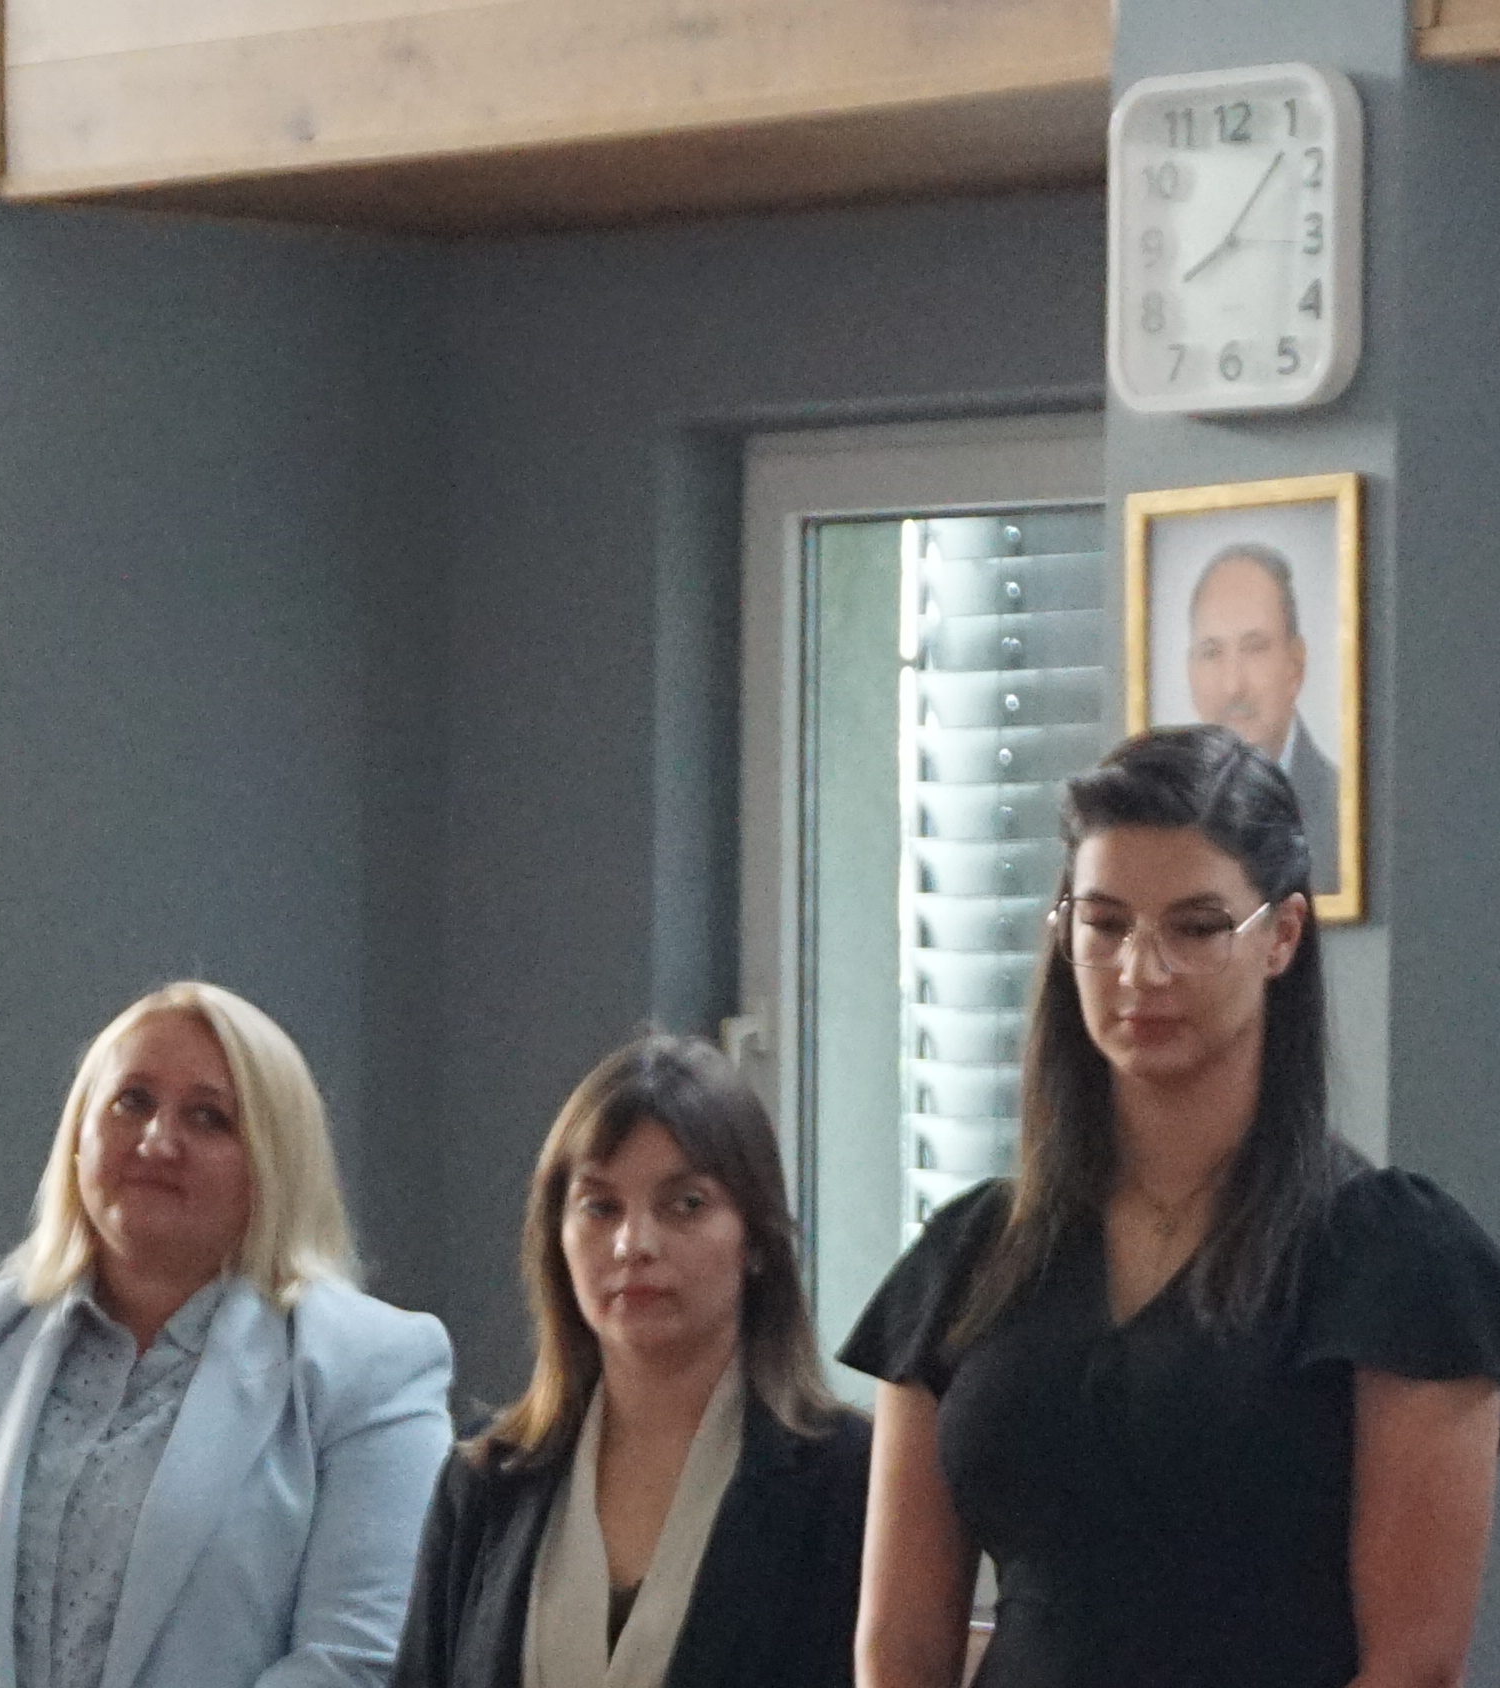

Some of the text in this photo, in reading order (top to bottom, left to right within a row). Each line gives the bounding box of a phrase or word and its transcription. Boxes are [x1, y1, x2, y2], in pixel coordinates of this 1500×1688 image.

[1164, 108, 1195, 148] 11
[1214, 102, 1250, 143] 12
[1284, 98, 1298, 138] 1
[1142, 161, 1179, 200] 10
[1303, 146, 1324, 189] 2
[1141, 227, 1164, 268] 9
[1303, 211, 1324, 255] 3
[1140, 290, 1166, 333] 8
[1299, 278, 1322, 320] 4
[1168, 343, 1188, 382] 7
[1219, 340, 1243, 381] 6
[1276, 335, 1299, 375] 5
